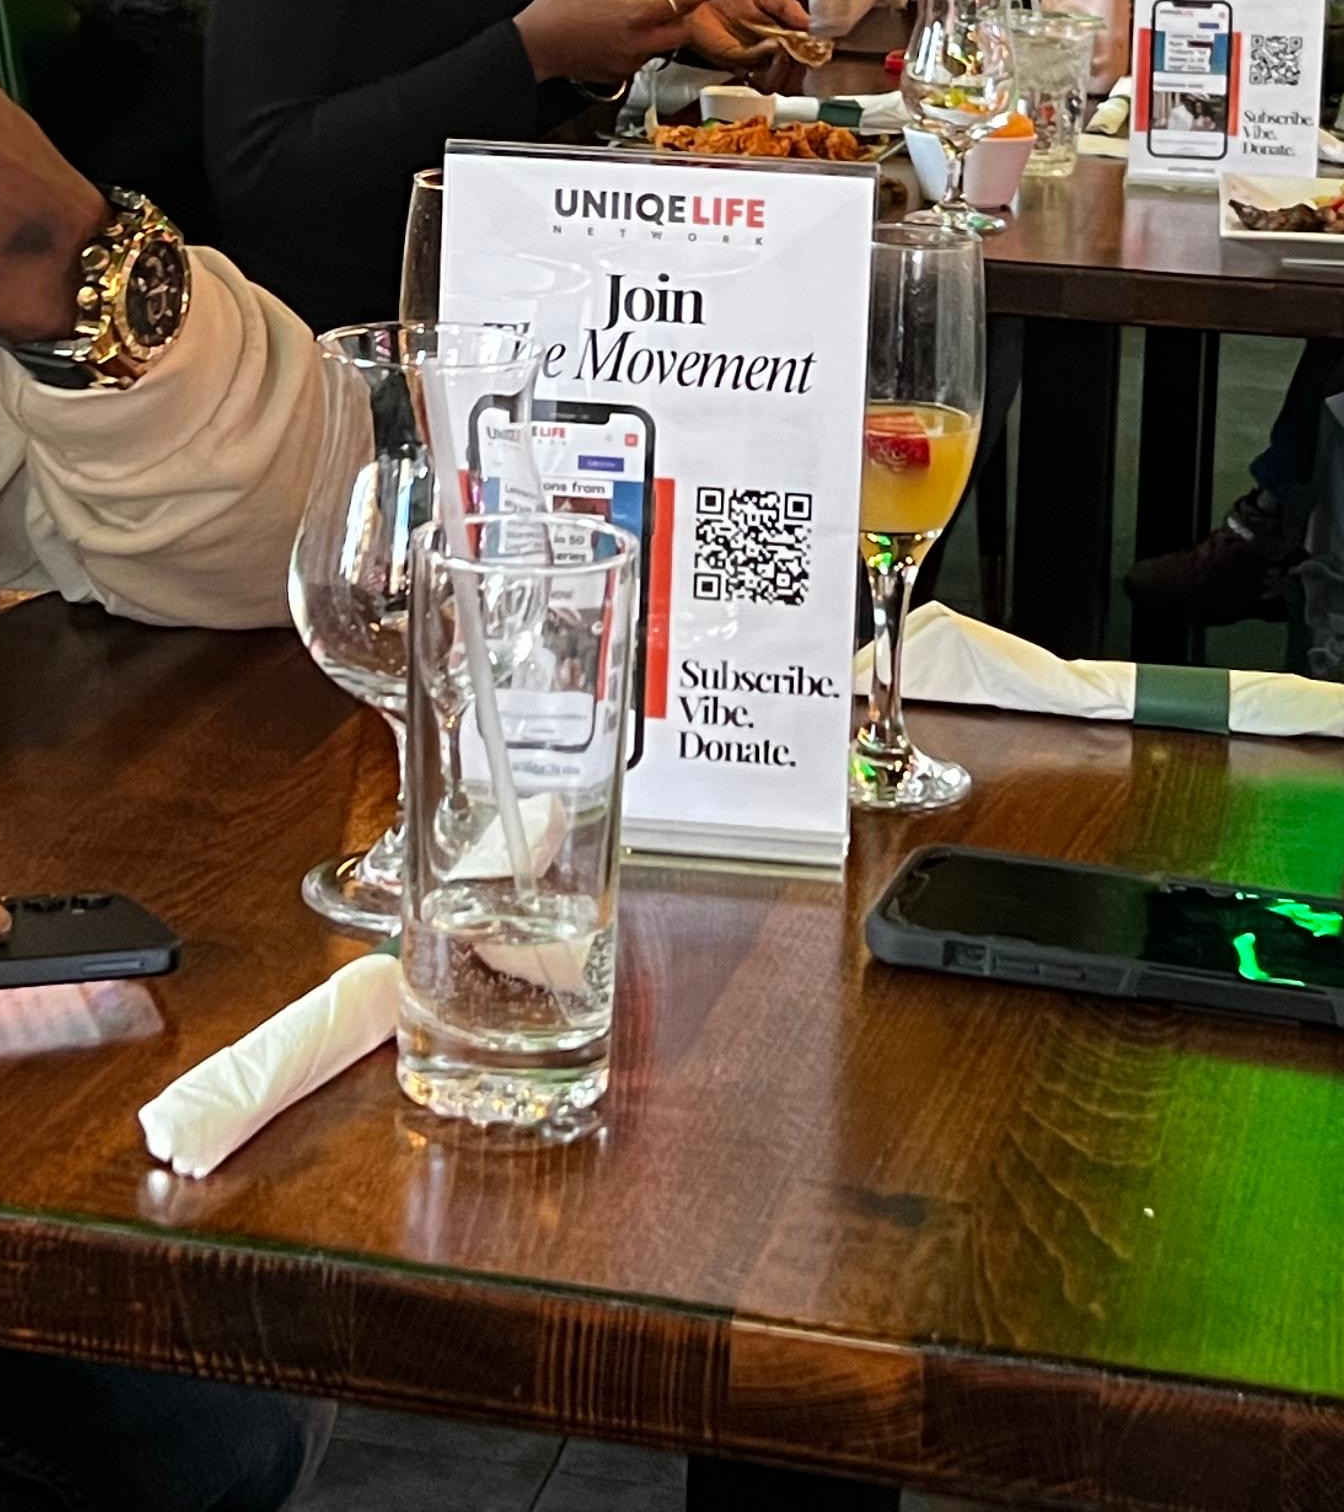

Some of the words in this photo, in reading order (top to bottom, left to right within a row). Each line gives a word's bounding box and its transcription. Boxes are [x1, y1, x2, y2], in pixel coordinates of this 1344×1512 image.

[605, 273, 706, 331] Join
[573, 328, 818, 395] Movement
[679, 659, 841, 699] Subscribe.
[678, 695, 754, 729] Vibe.
[678, 730, 797, 768] Donate.
